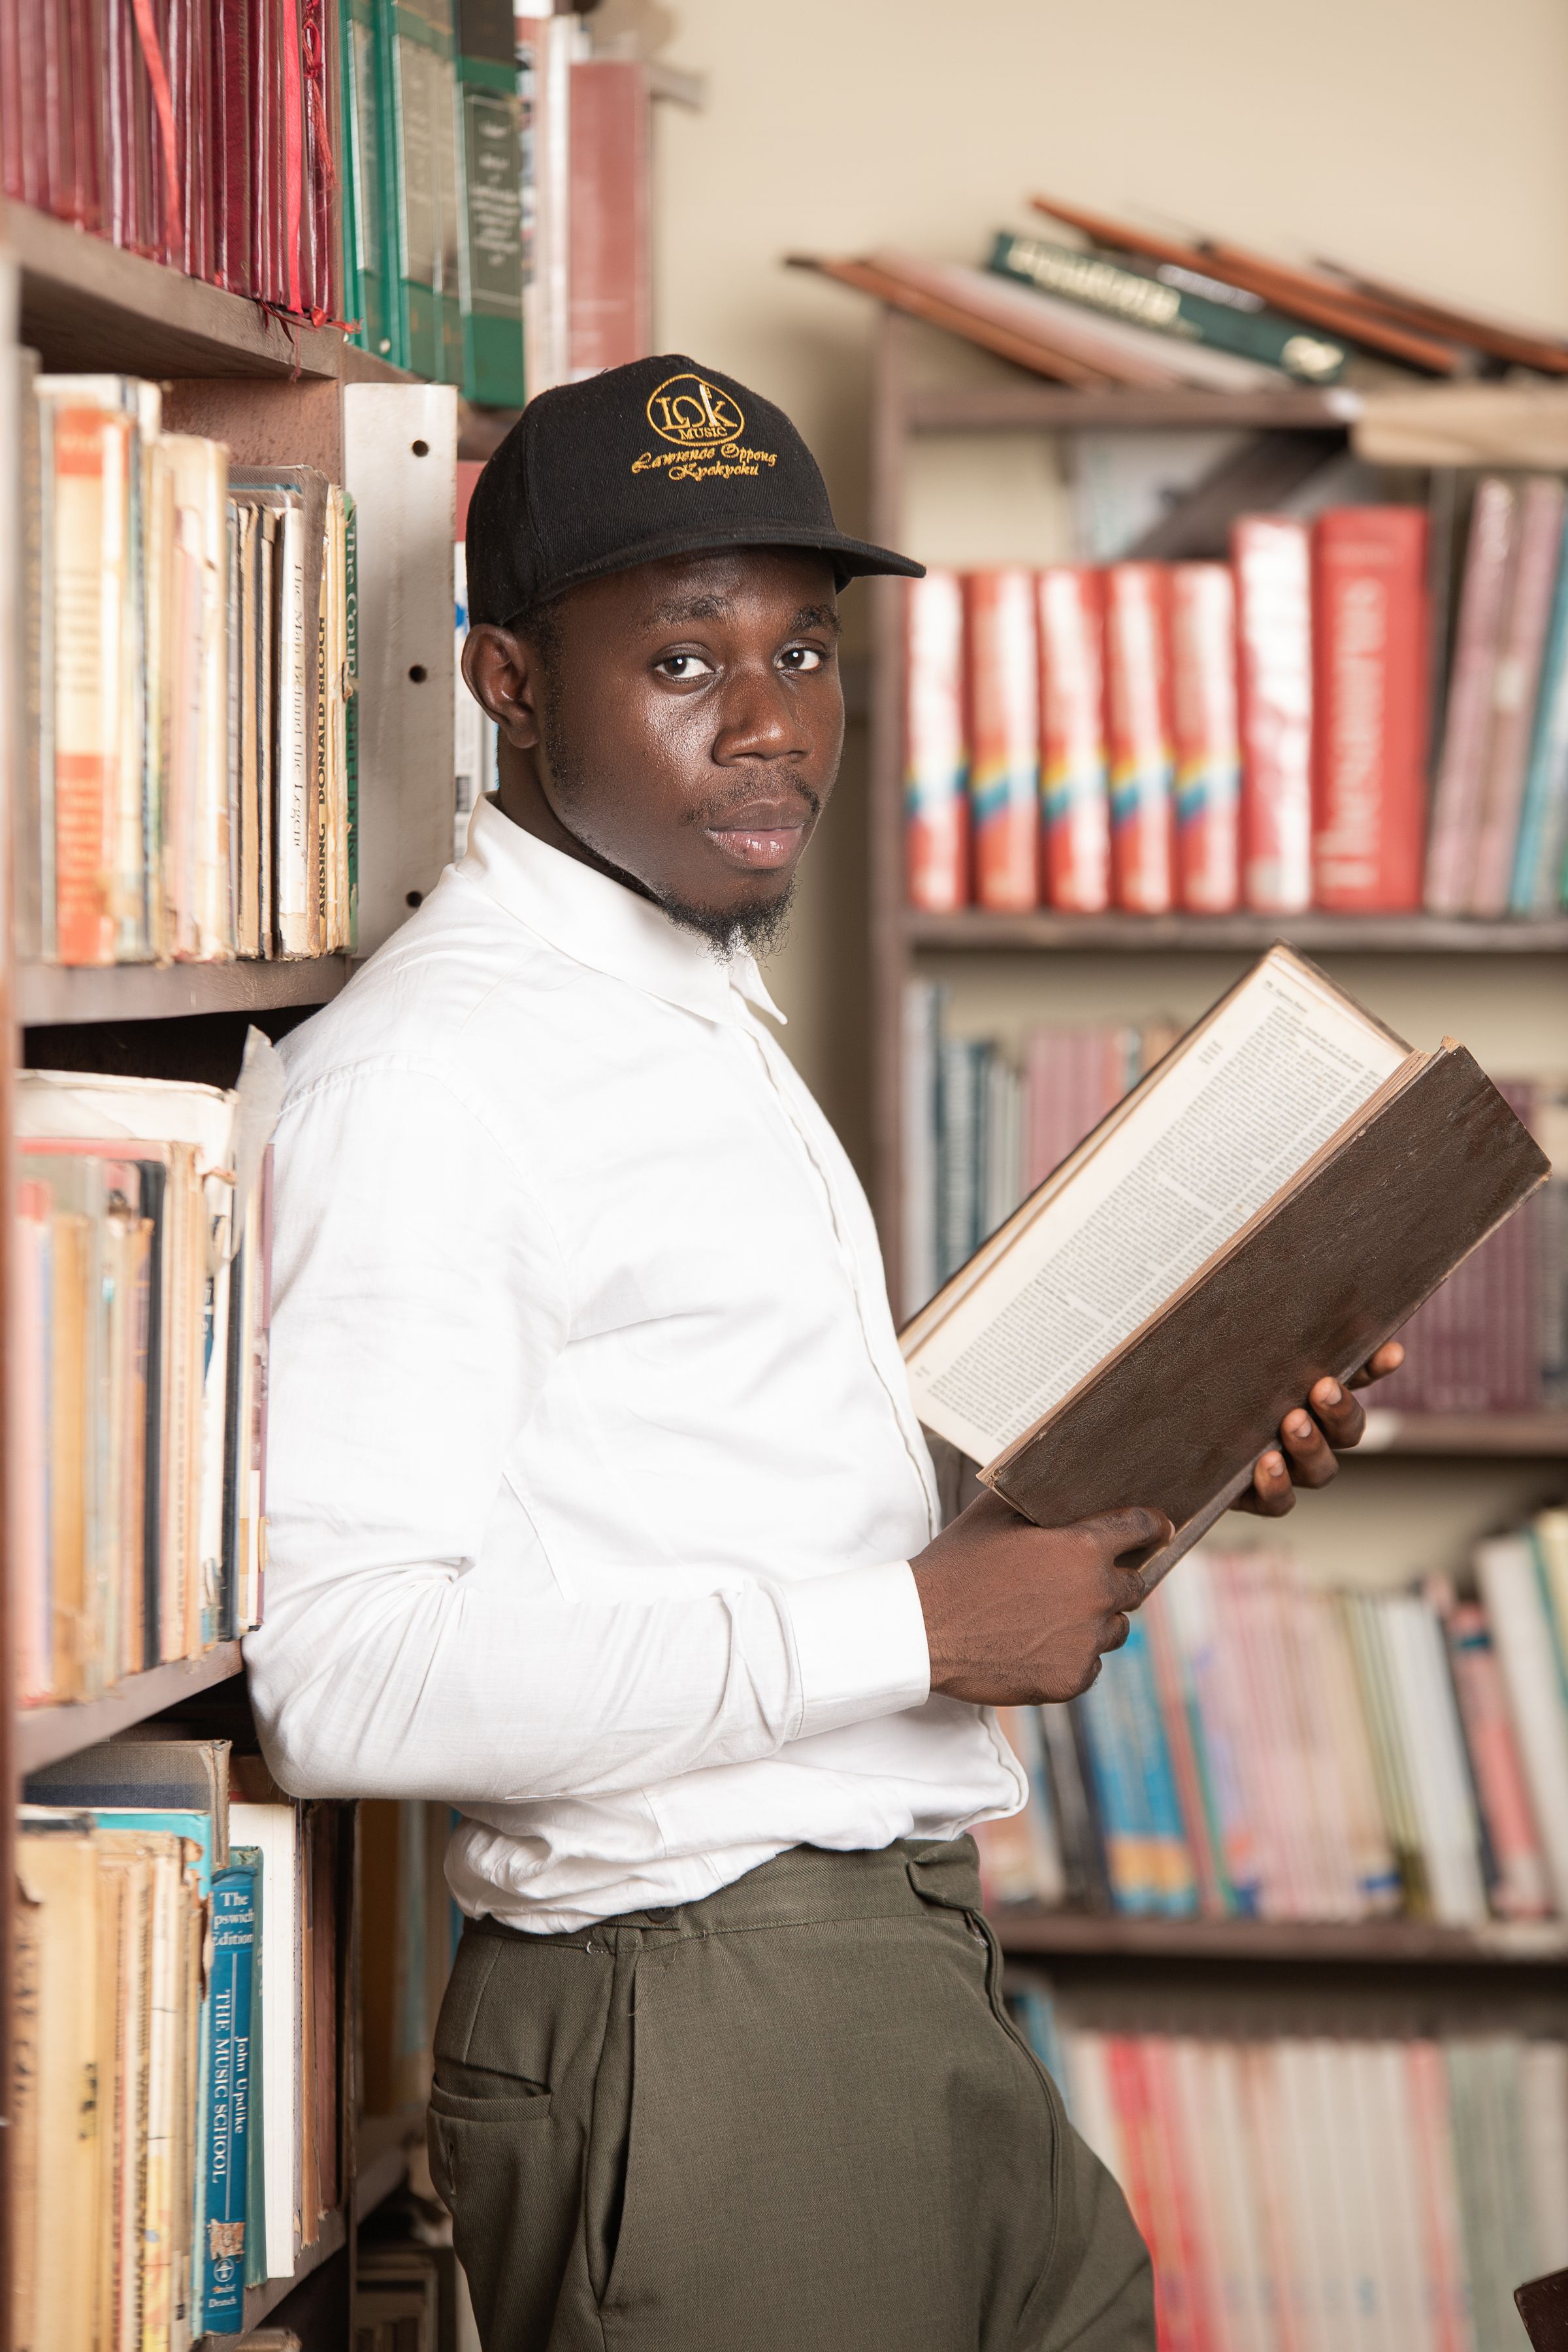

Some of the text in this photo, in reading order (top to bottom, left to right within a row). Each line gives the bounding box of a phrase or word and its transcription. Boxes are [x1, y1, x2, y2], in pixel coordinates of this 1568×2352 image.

[678, 427, 728, 440] MUSIC
[632, 443, 777, 474] Lawrence Oppong
[347, 593, 358, 677] Coup
[220, 1892, 250, 1906] The
[212, 1908, 254, 1930] pswich
[212, 1989, 231, 2184] THE MUSIC SCHOOL
[232, 2036, 249, 2134] John Updike
